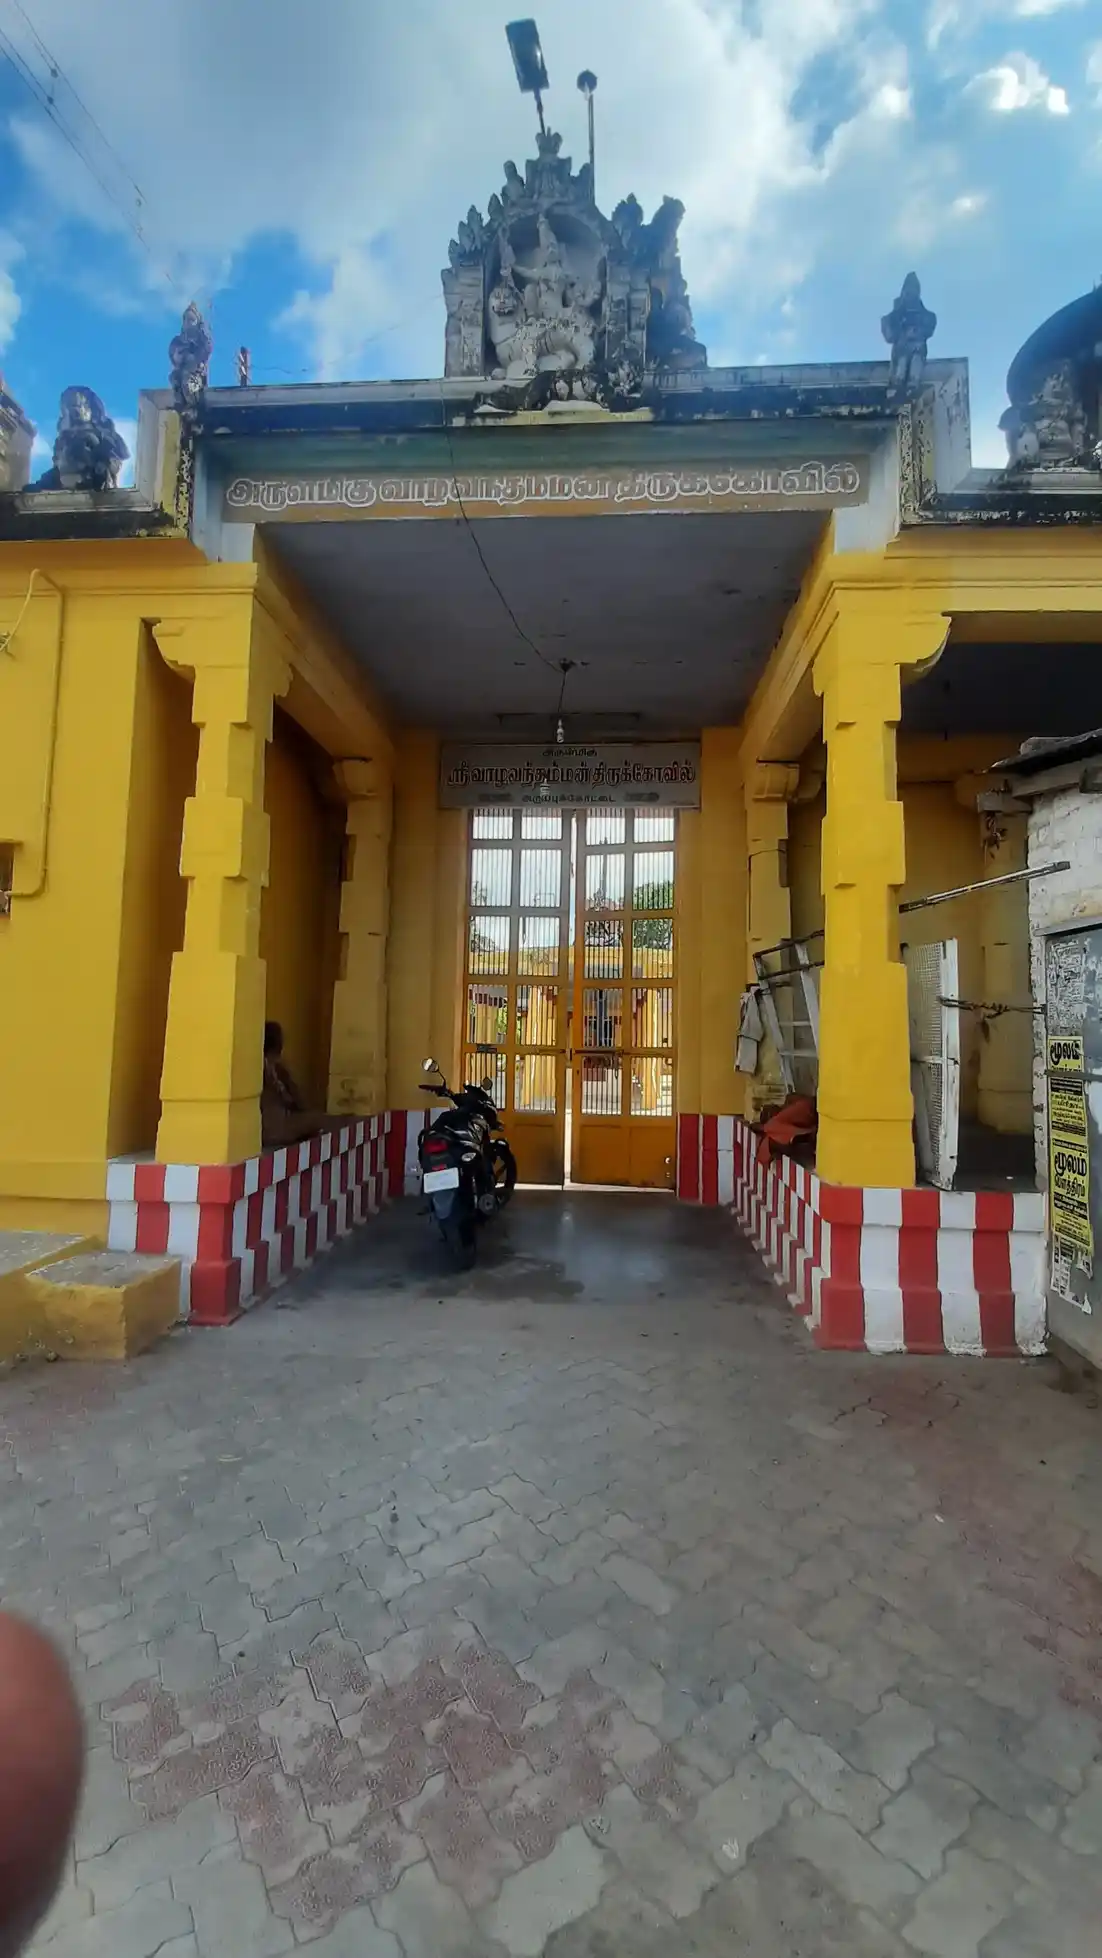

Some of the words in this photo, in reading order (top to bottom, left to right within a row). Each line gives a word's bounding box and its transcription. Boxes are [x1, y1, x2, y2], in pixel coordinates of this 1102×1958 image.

[592, 759, 697, 789] திருக்கோவில்
[1050, 1040, 1081, 1065] மூலம்
[1054, 1151, 1088, 1176] மூலம்
